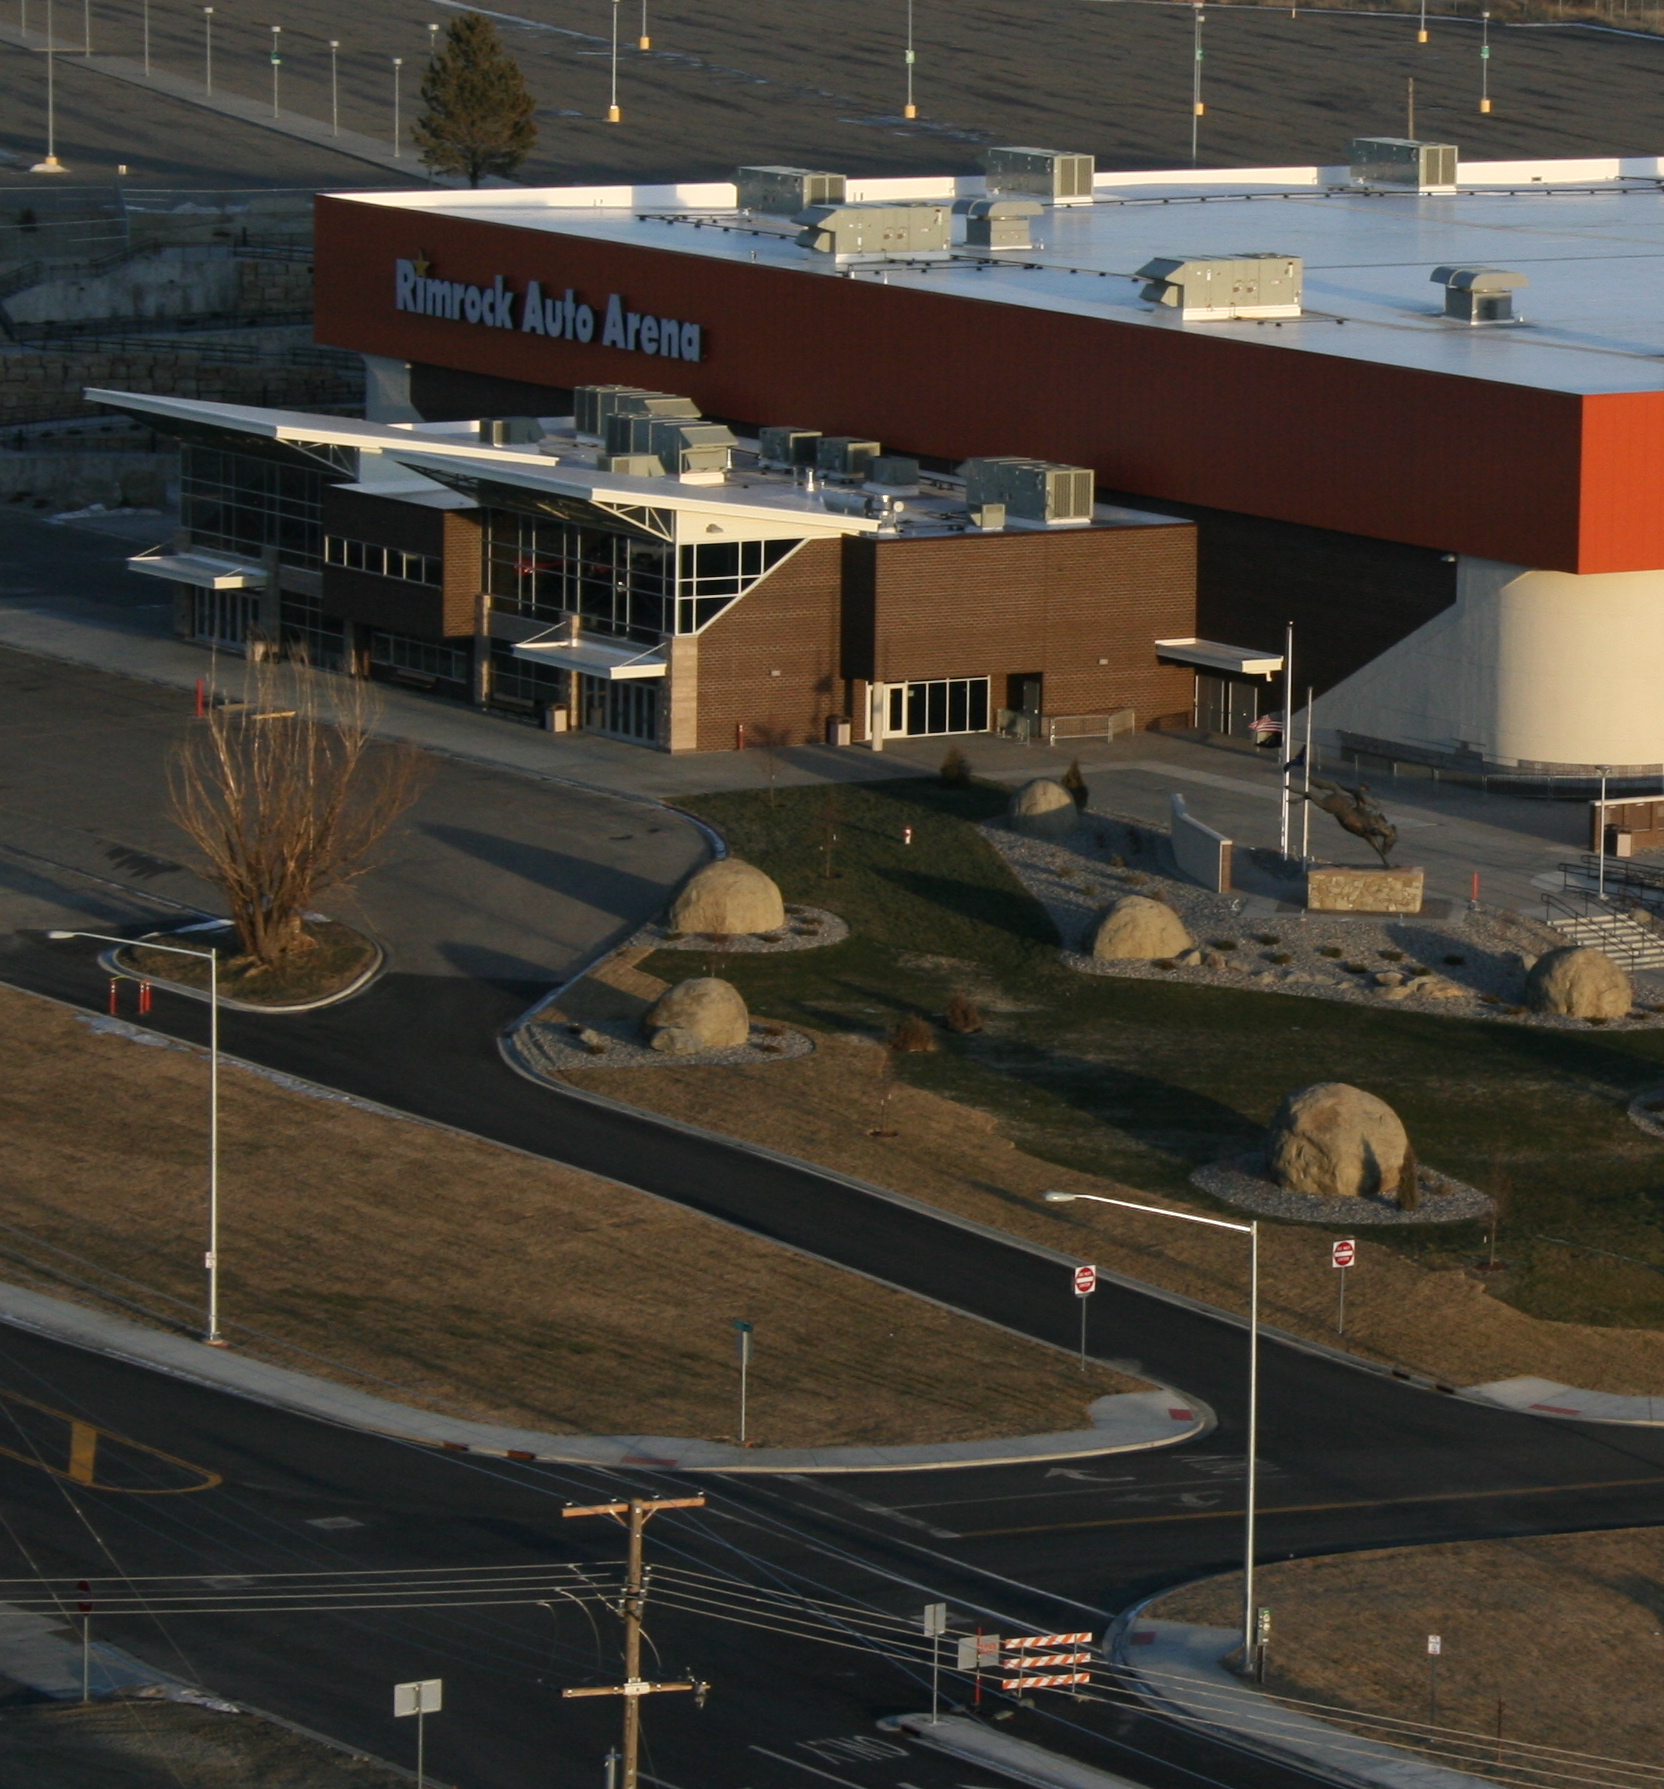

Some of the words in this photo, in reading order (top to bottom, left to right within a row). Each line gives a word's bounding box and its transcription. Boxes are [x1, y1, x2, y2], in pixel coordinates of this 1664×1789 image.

[395, 250, 517, 330] Rimrock
[521, 280, 595, 344] Auto
[602, 293, 701, 363] Arena
